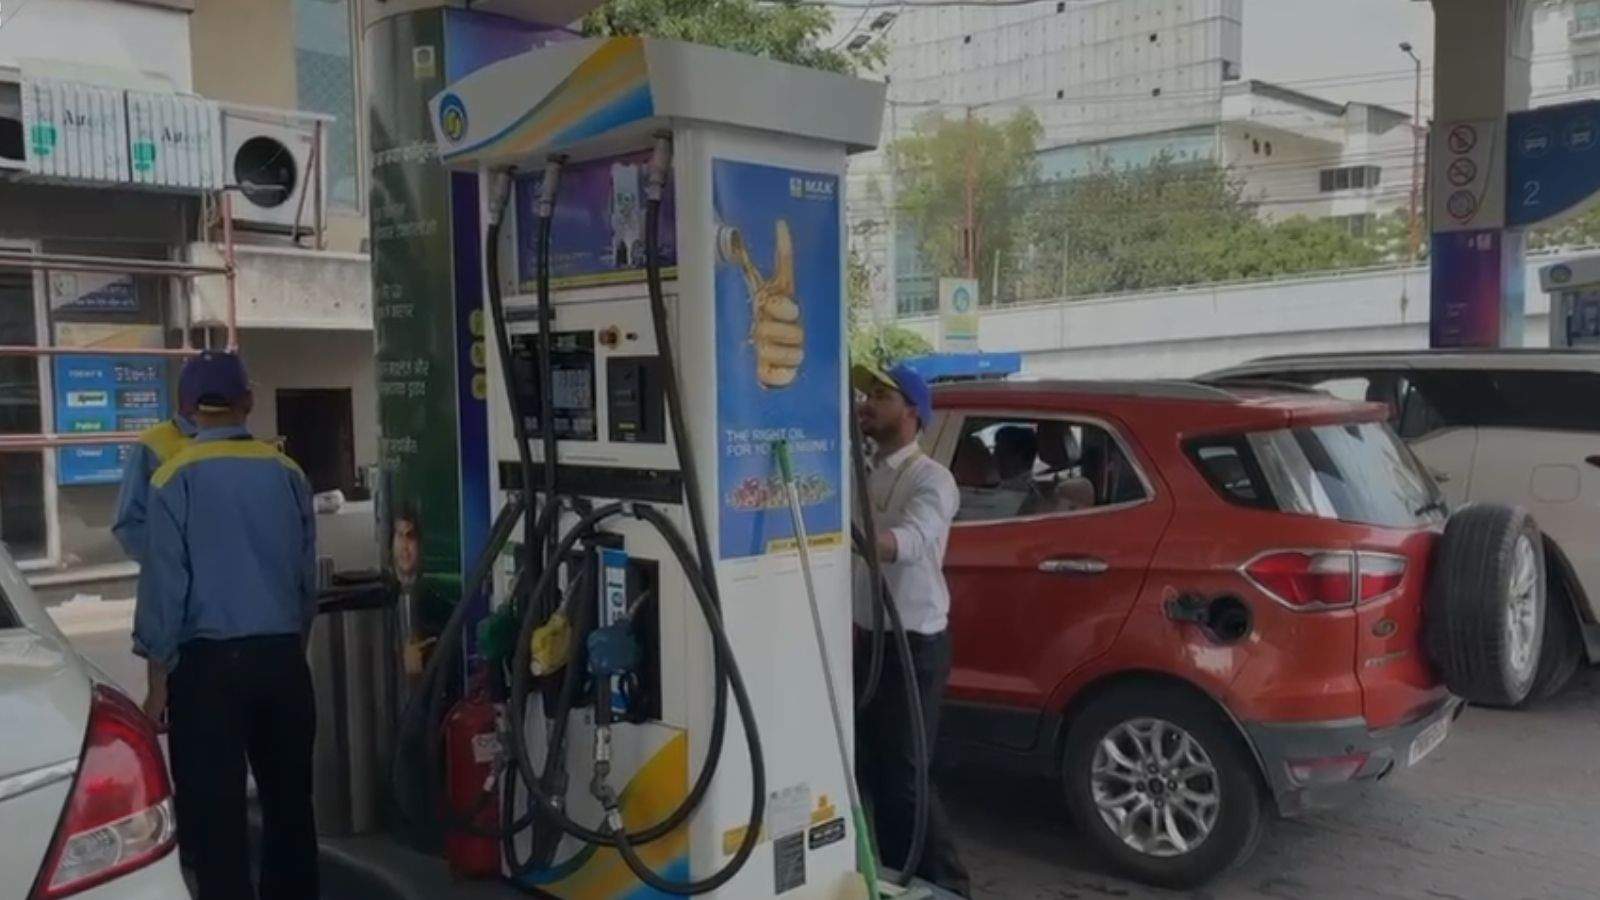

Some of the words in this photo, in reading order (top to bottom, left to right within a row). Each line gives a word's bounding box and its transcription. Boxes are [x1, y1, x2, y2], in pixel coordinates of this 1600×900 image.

[1523, 181, 1541, 205] 2
[726, 430, 750, 442] THE
[726, 444, 751, 457] FOR
